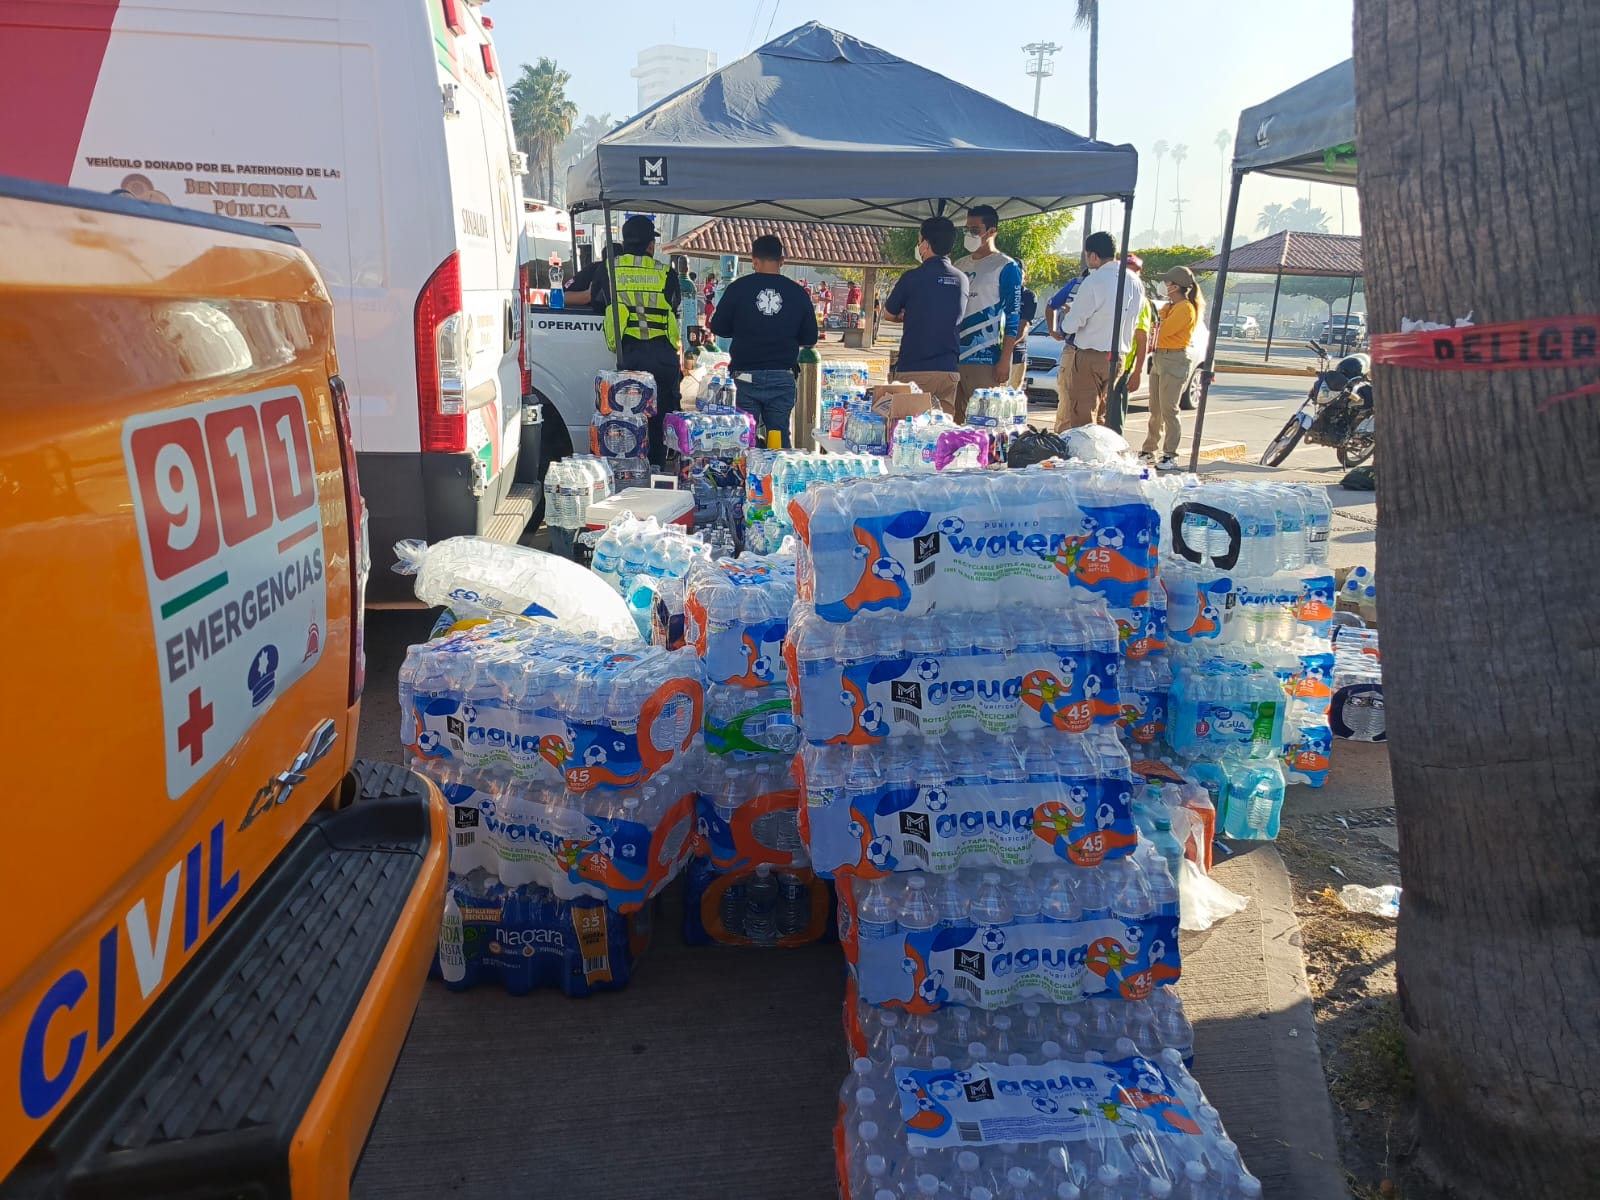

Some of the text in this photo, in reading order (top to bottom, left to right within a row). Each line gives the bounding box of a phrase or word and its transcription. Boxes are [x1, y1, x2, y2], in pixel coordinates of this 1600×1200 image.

[86, 157, 341, 178] VEHÍCULO DONADO POR EL PATRIMONIO DE LA:
[184, 178, 317, 200] BENEFICENCIA
[213, 200, 291, 218] PÚBLICA
[155, 414, 303, 550] 911
[984, 521, 1039, 529] PURIFIED
[948, 531, 1066, 558] water
[1087, 550, 1111, 563] 45
[166, 548, 323, 682] EMERGENCIAS
[1303, 602, 1319, 610] 45
[1136, 640, 1148, 649] 45
[928, 676, 1022, 706] agua
[1300, 679, 1314, 687] 45
[1067, 703, 1090, 720] 45
[1143, 724, 1155, 734] 45
[1217, 720, 1246, 729] AGUA
[468, 726, 540, 754] agua
[1302, 752, 1316, 760] 45
[568, 769, 590, 782] 45
[936, 807, 1035, 838] agua
[485, 816, 565, 850] water
[1082, 835, 1103, 851] 45
[589, 854, 608, 870] 45
[582, 916, 600, 928] 35
[496, 928, 564, 949] niagara
[19, 819, 240, 1119] CIVIL
[991, 944, 1088, 977] agua
[997, 1075, 1097, 1098] agua
